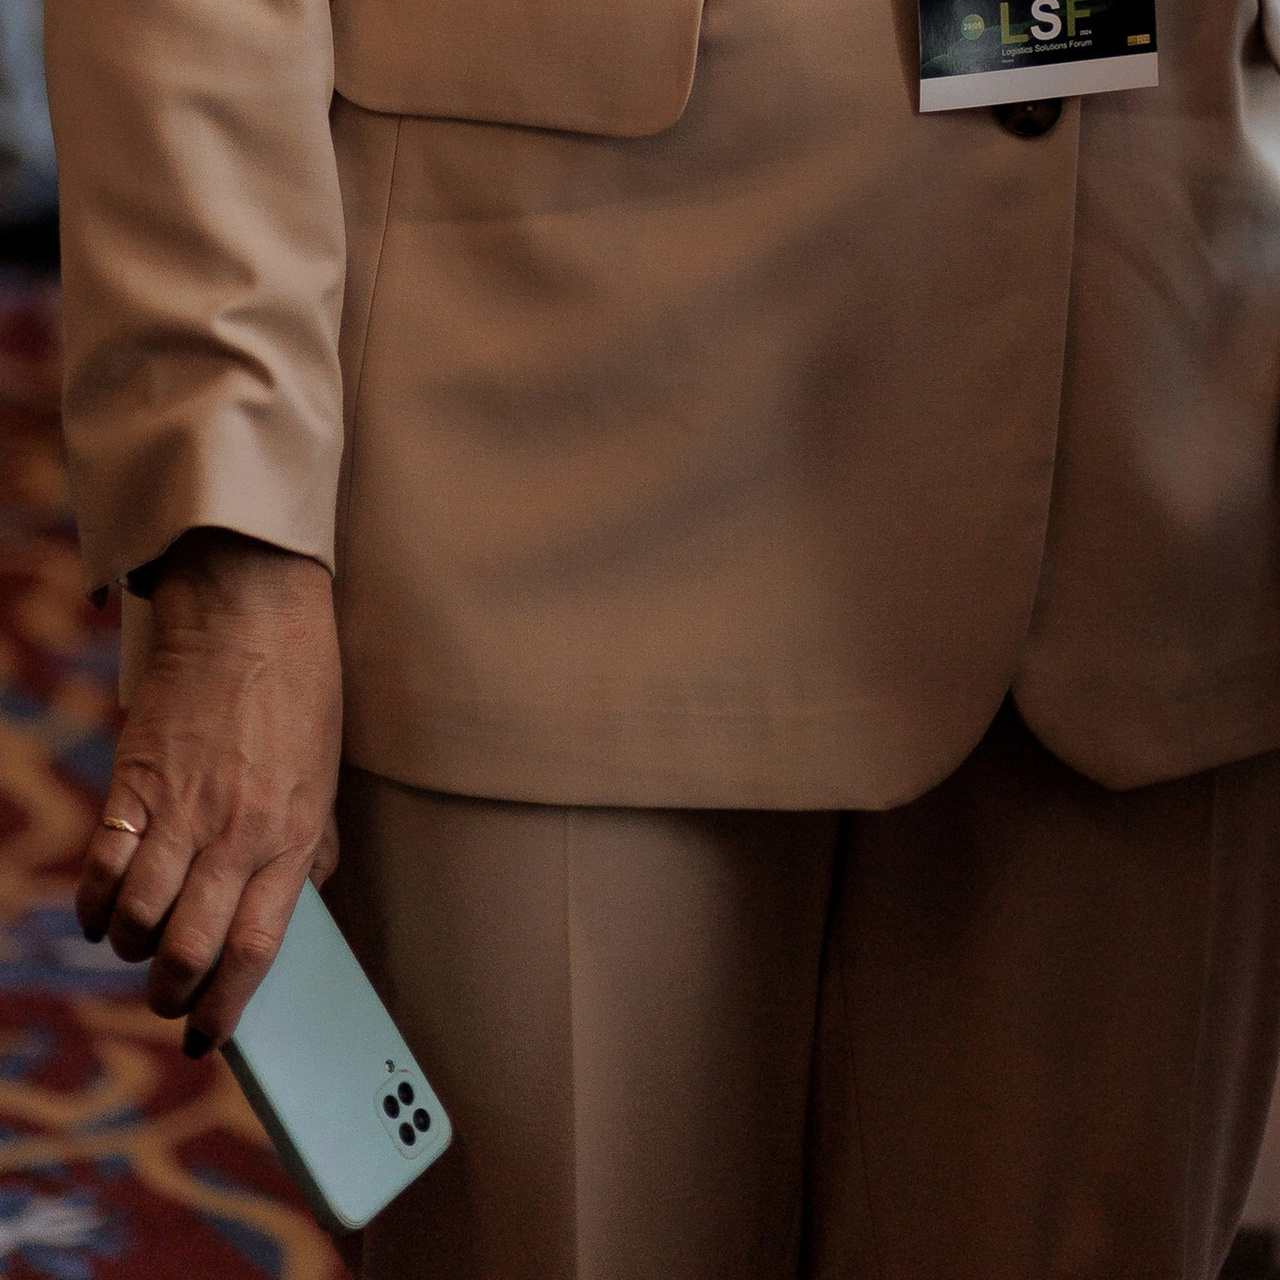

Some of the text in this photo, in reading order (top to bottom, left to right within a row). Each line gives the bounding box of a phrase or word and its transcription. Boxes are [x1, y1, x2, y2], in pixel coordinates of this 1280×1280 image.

[1001, 39, 1093, 57] Logistics Solutions Forum
